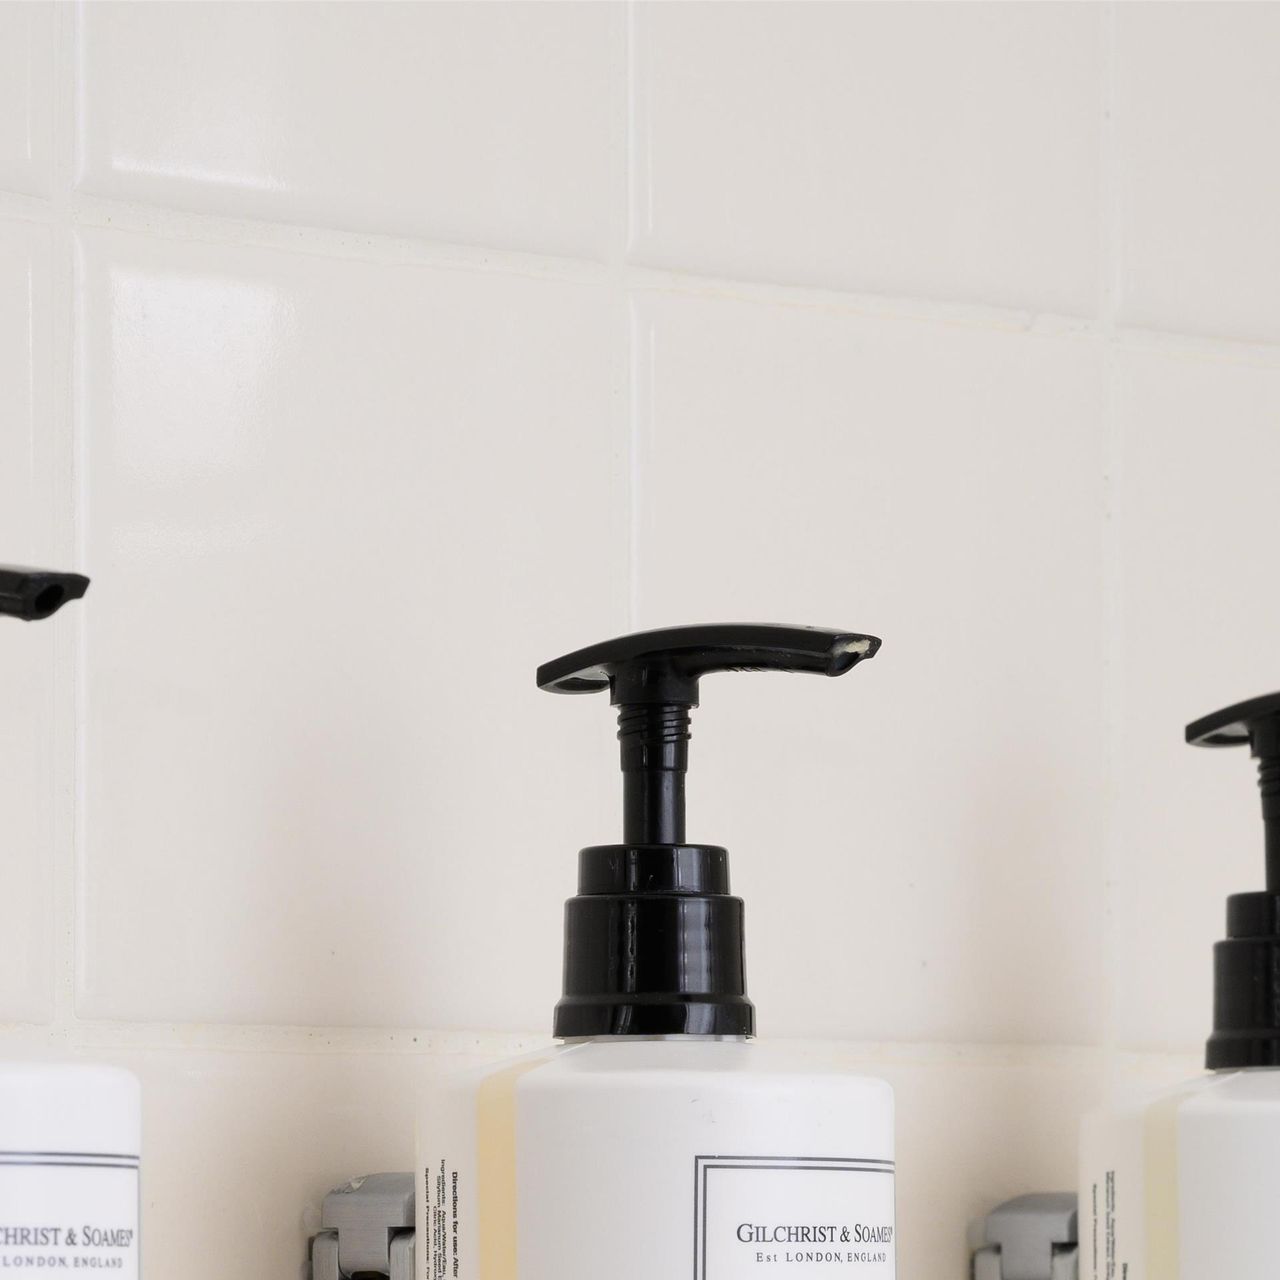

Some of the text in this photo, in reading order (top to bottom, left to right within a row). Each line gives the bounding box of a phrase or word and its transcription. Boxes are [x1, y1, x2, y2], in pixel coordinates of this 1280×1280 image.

[65, 1229, 77, 1247] &
[737, 1223, 837, 1243] GILCHRIST
[840, 1226, 851, 1243] &
[73, 1257, 123, 1269] ENGLAND
[756, 1252, 887, 1264] Est LONDON, ENGLAND
